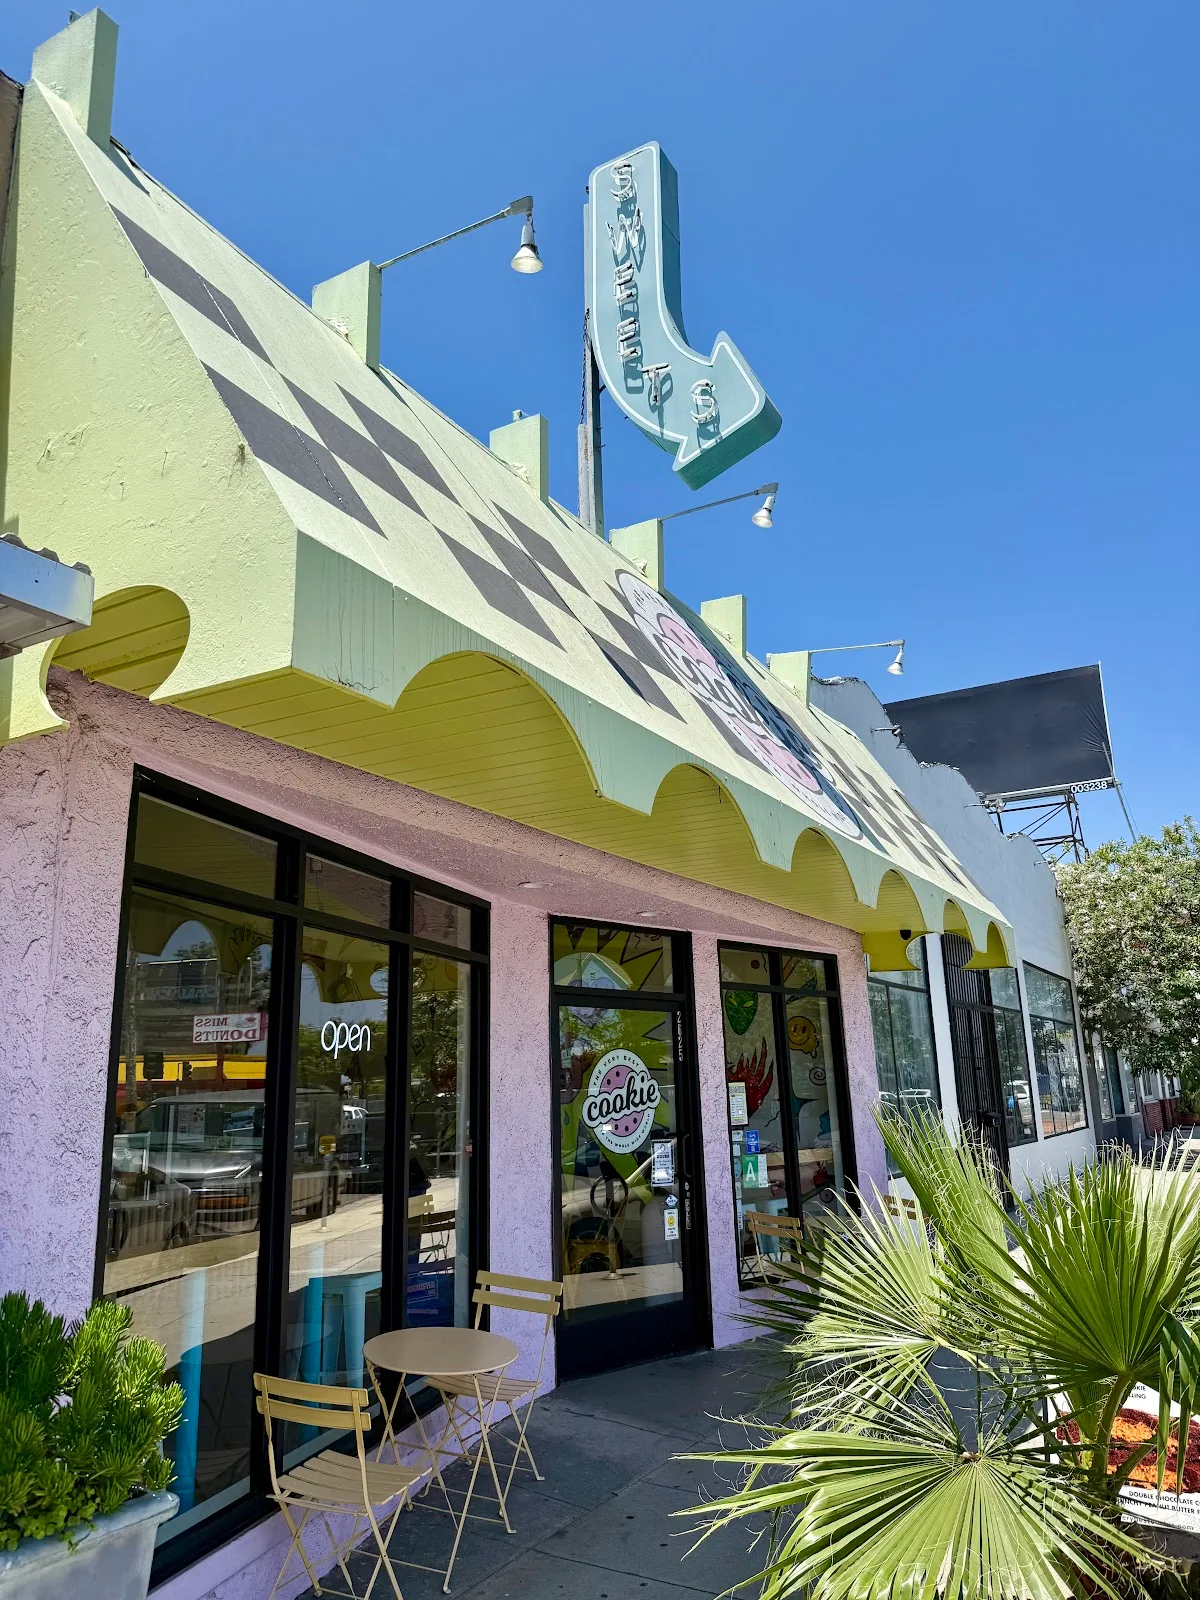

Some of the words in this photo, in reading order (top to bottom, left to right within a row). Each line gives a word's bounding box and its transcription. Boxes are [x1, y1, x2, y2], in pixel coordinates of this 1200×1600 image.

[605, 160, 720, 424] SWEETS
[1070, 781, 1108, 793] 003238
[603, 1055, 620, 1067] VERY
[623, 1055, 639, 1068] BEST
[587, 1075, 658, 1122] cookie
[746, 1162, 756, 1181] A
[1129, 1490, 1154, 1500] DOUBLE
[1156, 1494, 1194, 1505] CHOCOLATE
[1171, 1506, 1195, 1514] BUTTER
